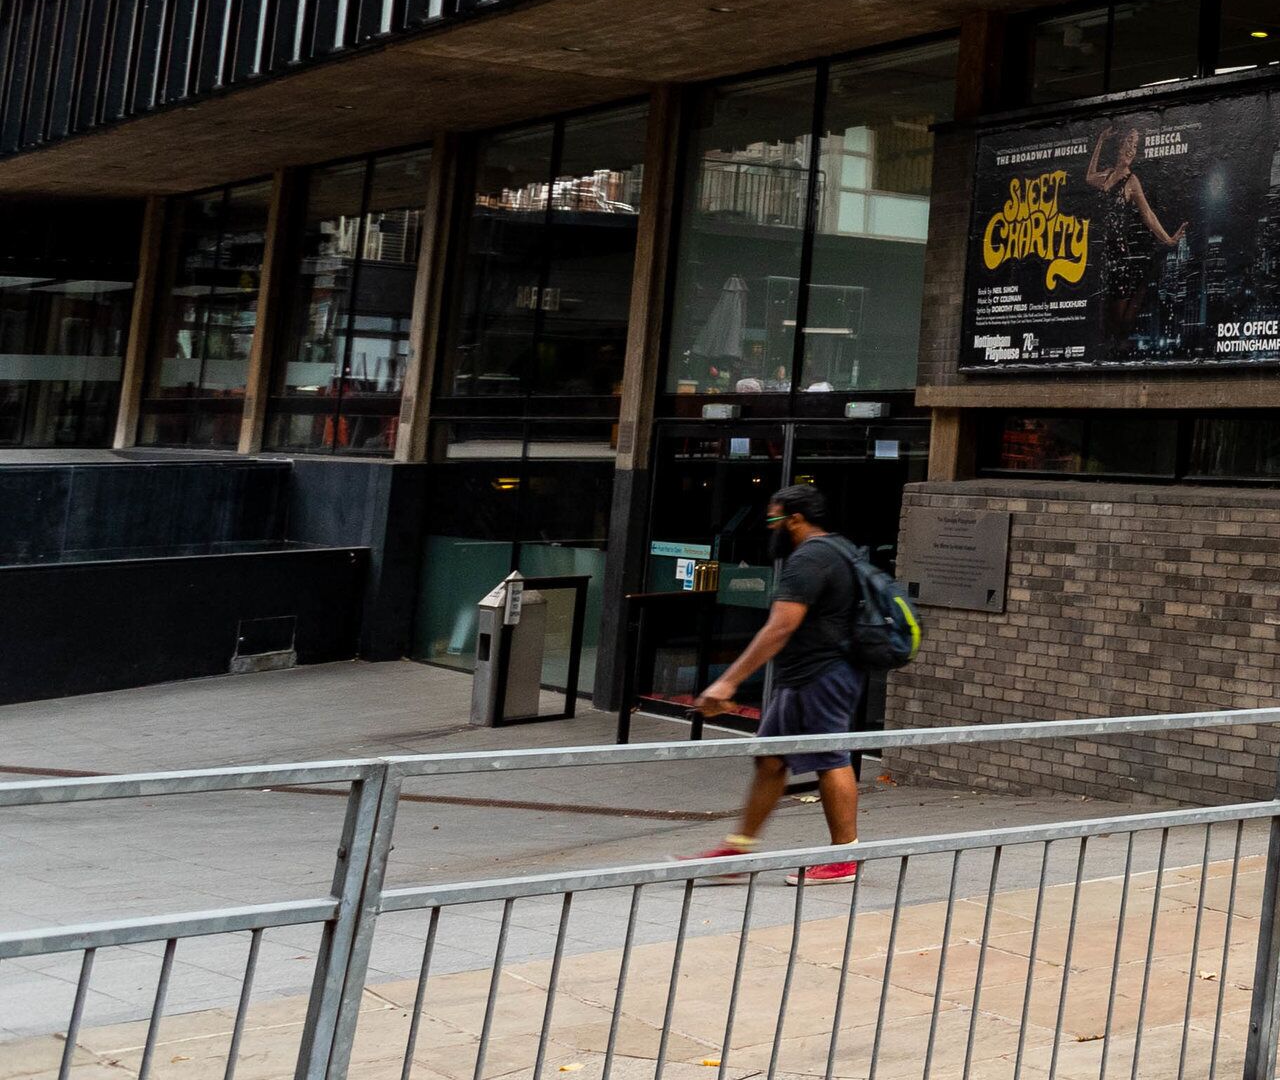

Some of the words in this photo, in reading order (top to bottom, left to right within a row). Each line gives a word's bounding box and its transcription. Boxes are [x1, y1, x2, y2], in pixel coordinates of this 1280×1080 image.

[1145, 132, 1181, 147] REBECCA
[996, 155, 1009, 166] THE
[1011, 149, 1052, 164] BROADWAY
[1054, 144, 1088, 158] MUSICAL
[1003, 170, 1067, 222] SWEET
[983, 211, 1090, 290] CHARITY
[1217, 322, 1240, 337] BOX
[1243, 320, 1278, 336] OFFICE
